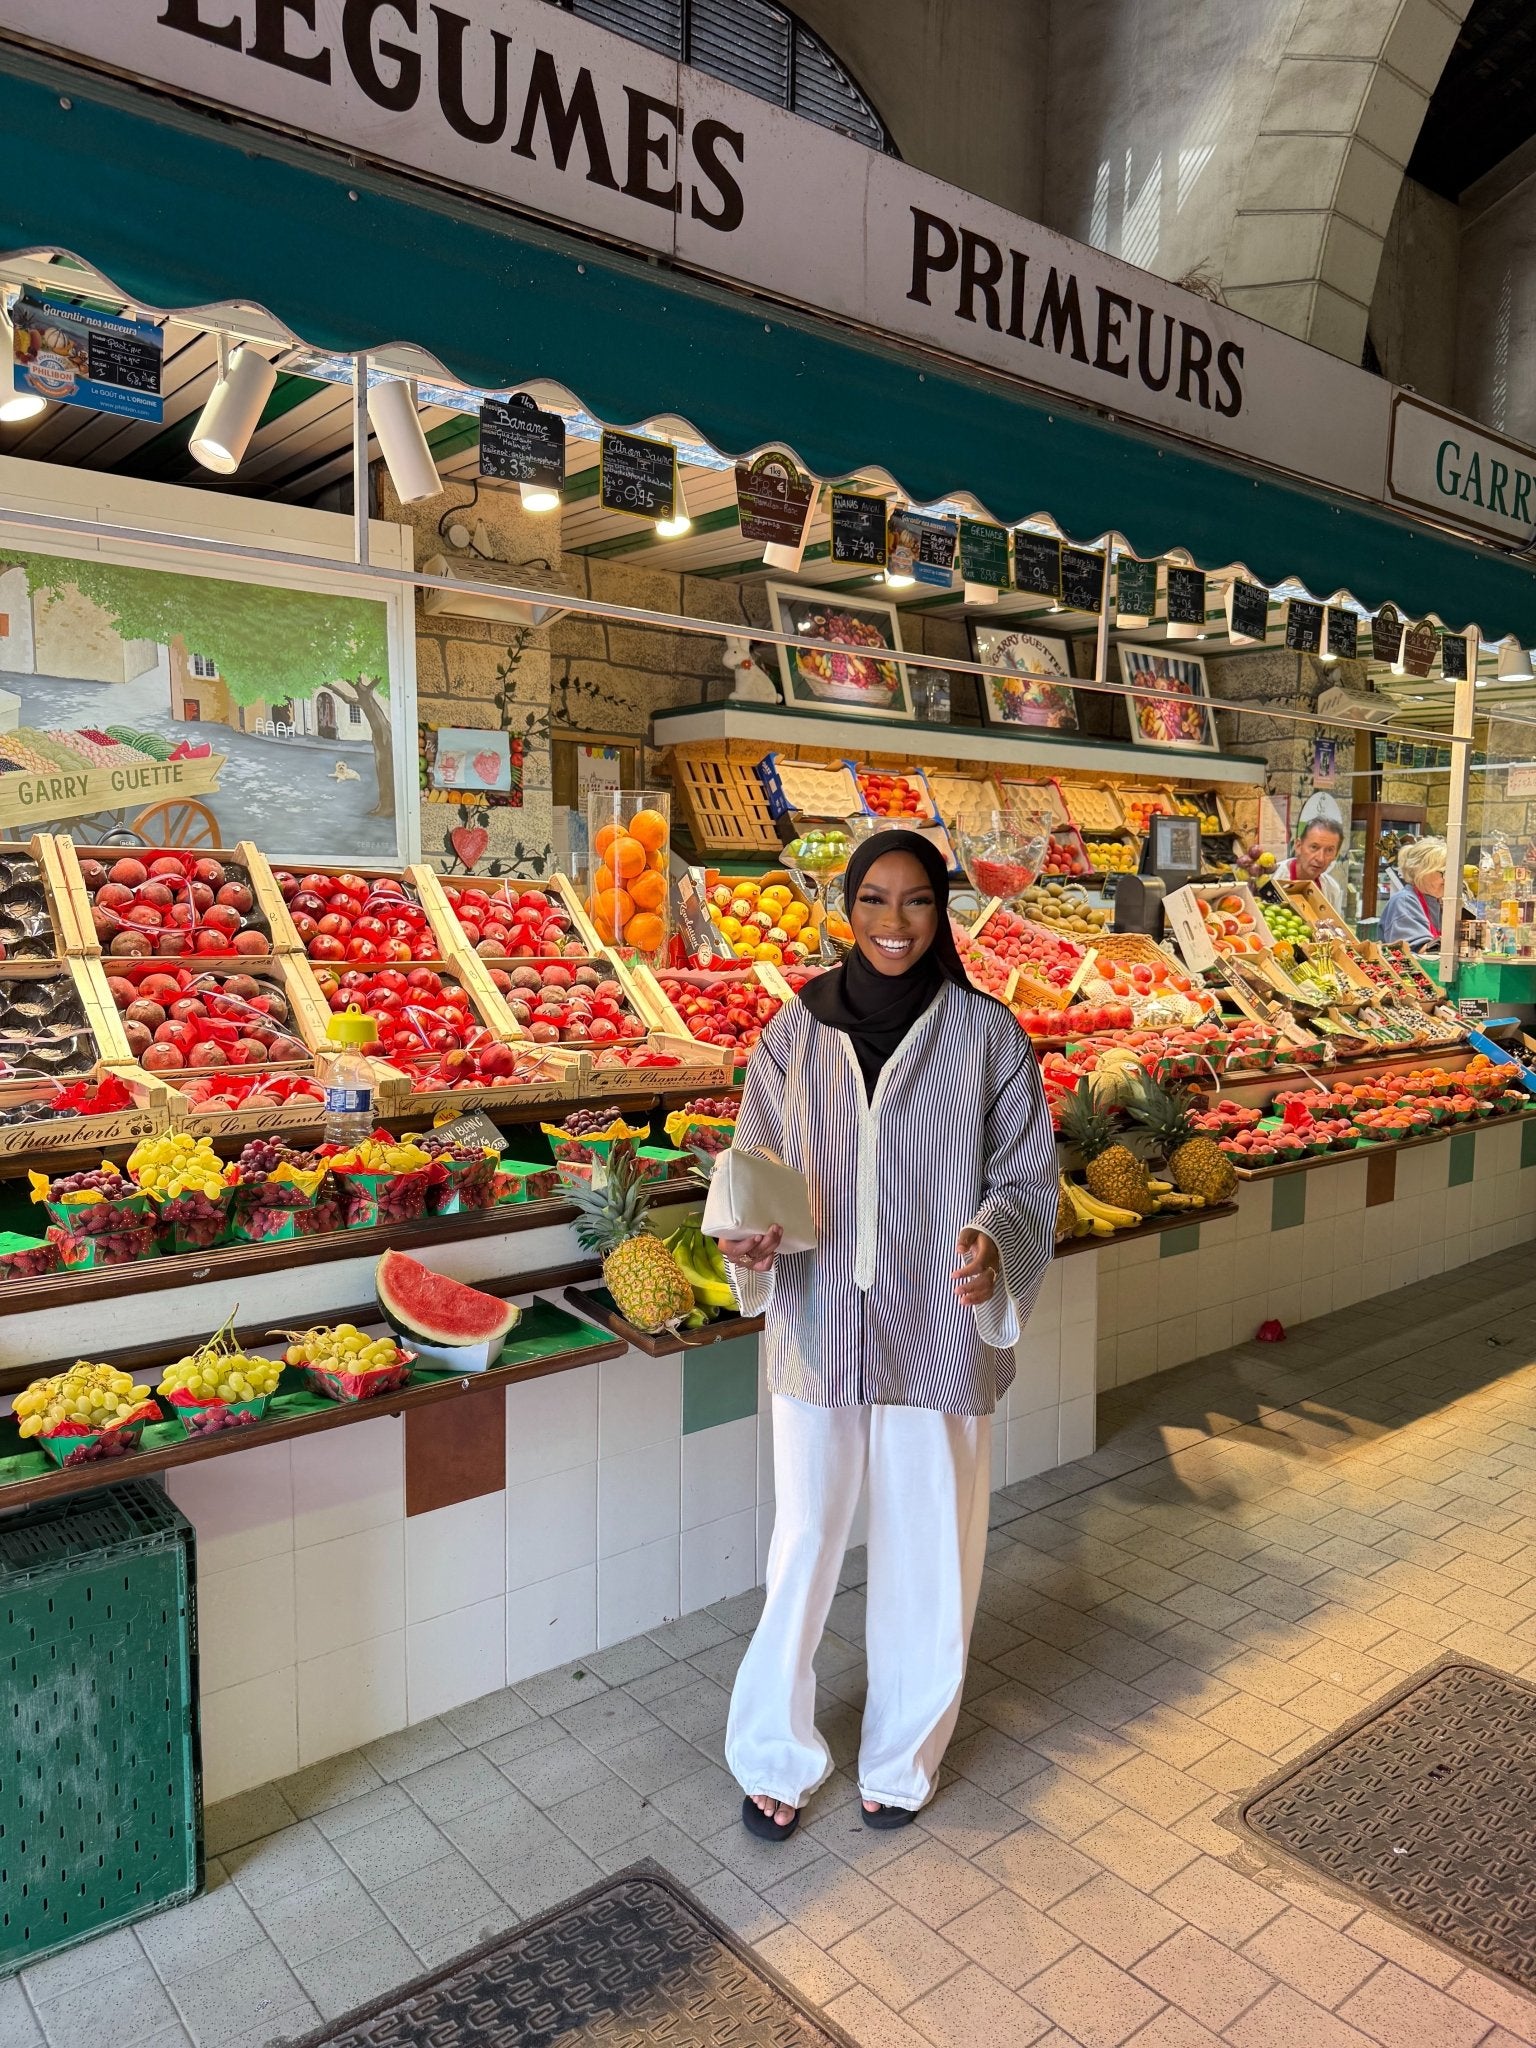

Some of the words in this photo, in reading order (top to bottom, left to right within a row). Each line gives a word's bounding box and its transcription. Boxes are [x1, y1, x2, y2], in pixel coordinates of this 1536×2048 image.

[43, 303, 85, 323] Garantir
[86, 317, 102, 328] nos
[103, 322, 138, 336] saveurs
[906, 205, 1245, 417] PRIMEURS
[32, 365, 73, 381] PHILIBON
[126, 396, 157, 408] L'ORIGINE
[769, 466, 782, 477] 1kg
[777, 482, 786, 493] €
[1436, 440, 1536, 526] GARR
[834, 498, 859, 510] ANANAS
[971, 525, 1004, 541] GRENADE
[1240, 584, 1269, 602] MANGUE
[992, 634, 1019, 665] GARRY
[18, 774, 89, 805] GARRY
[111, 764, 184, 792] GUETTE
[639, 1070, 706, 1084] Chamberts
[461, 1093, 541, 1111] Chamberts
[220, 1116, 246, 1134] Les
[256, 1109, 327, 1128] Chamb
[440, 1112, 455, 1122] 1kg
[455, 1116, 484, 1137] BLANC
[5, 1120, 122, 1152] Chamberts
